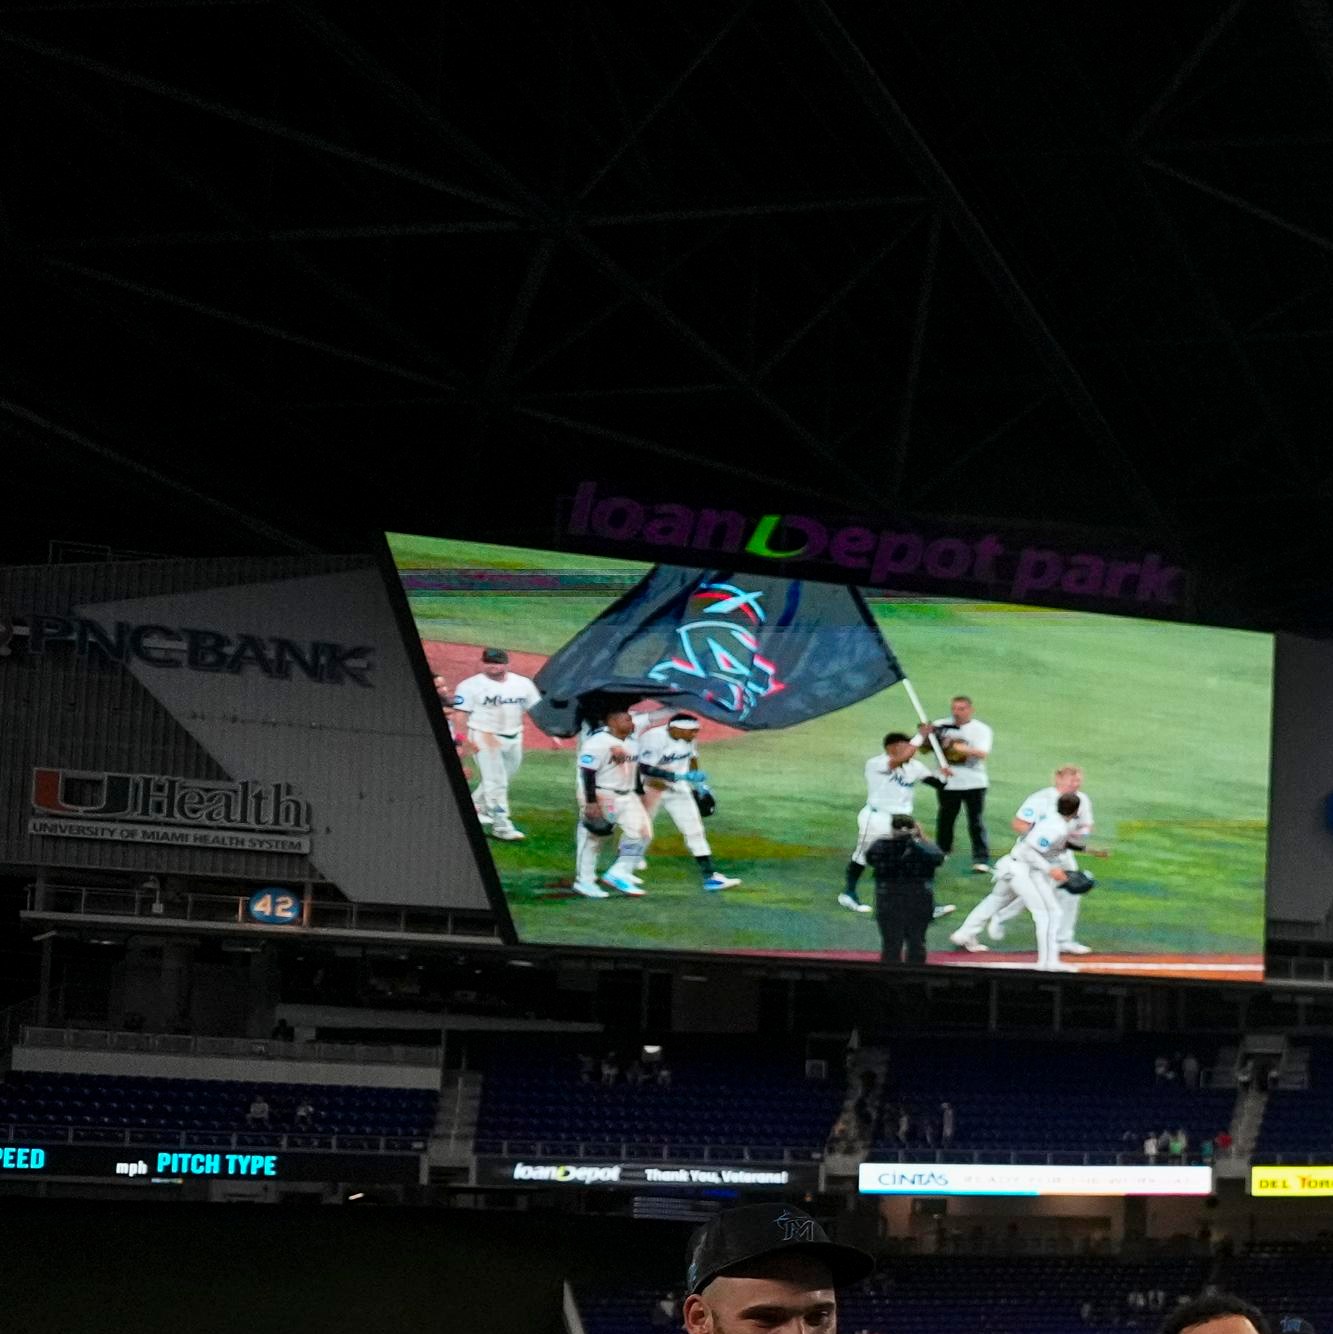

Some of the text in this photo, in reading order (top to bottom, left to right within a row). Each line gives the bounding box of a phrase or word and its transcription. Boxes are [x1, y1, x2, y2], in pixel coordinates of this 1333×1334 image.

[566, 480, 1189, 603] loanDepot park
[33, 822, 301, 850] UNIVERSITY OF MIAMI HEALTH SYSTEM
[253, 894, 295, 917] 42
[116, 1153, 278, 1177] mph PITCH TYPE
[513, 1162, 622, 1184] loanDepot
[645, 1168, 690, 1182] Thank
[878, 1172, 949, 1186] CINTAS
[1259, 1178, 1290, 1189] DEL
